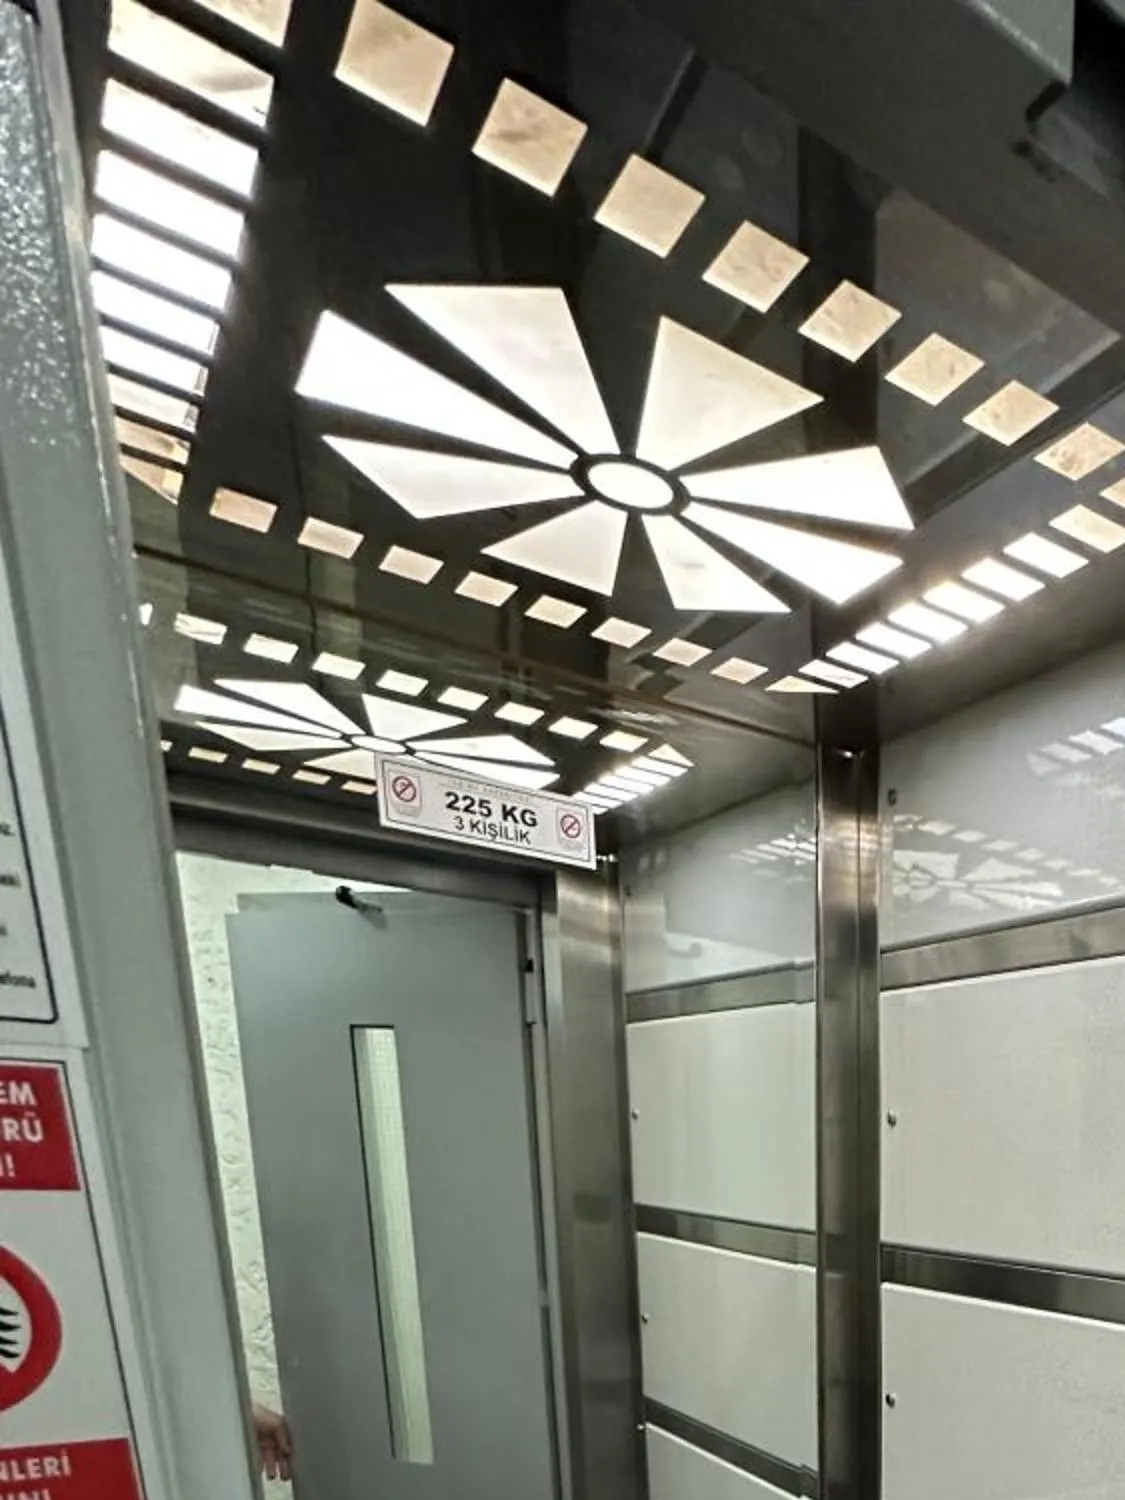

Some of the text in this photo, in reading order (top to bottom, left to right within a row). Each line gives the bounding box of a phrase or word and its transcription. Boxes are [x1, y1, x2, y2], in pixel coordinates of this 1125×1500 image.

[444, 791, 538, 828] 225 KG
[453, 815, 531, 845] 3 KİŞİLİK
